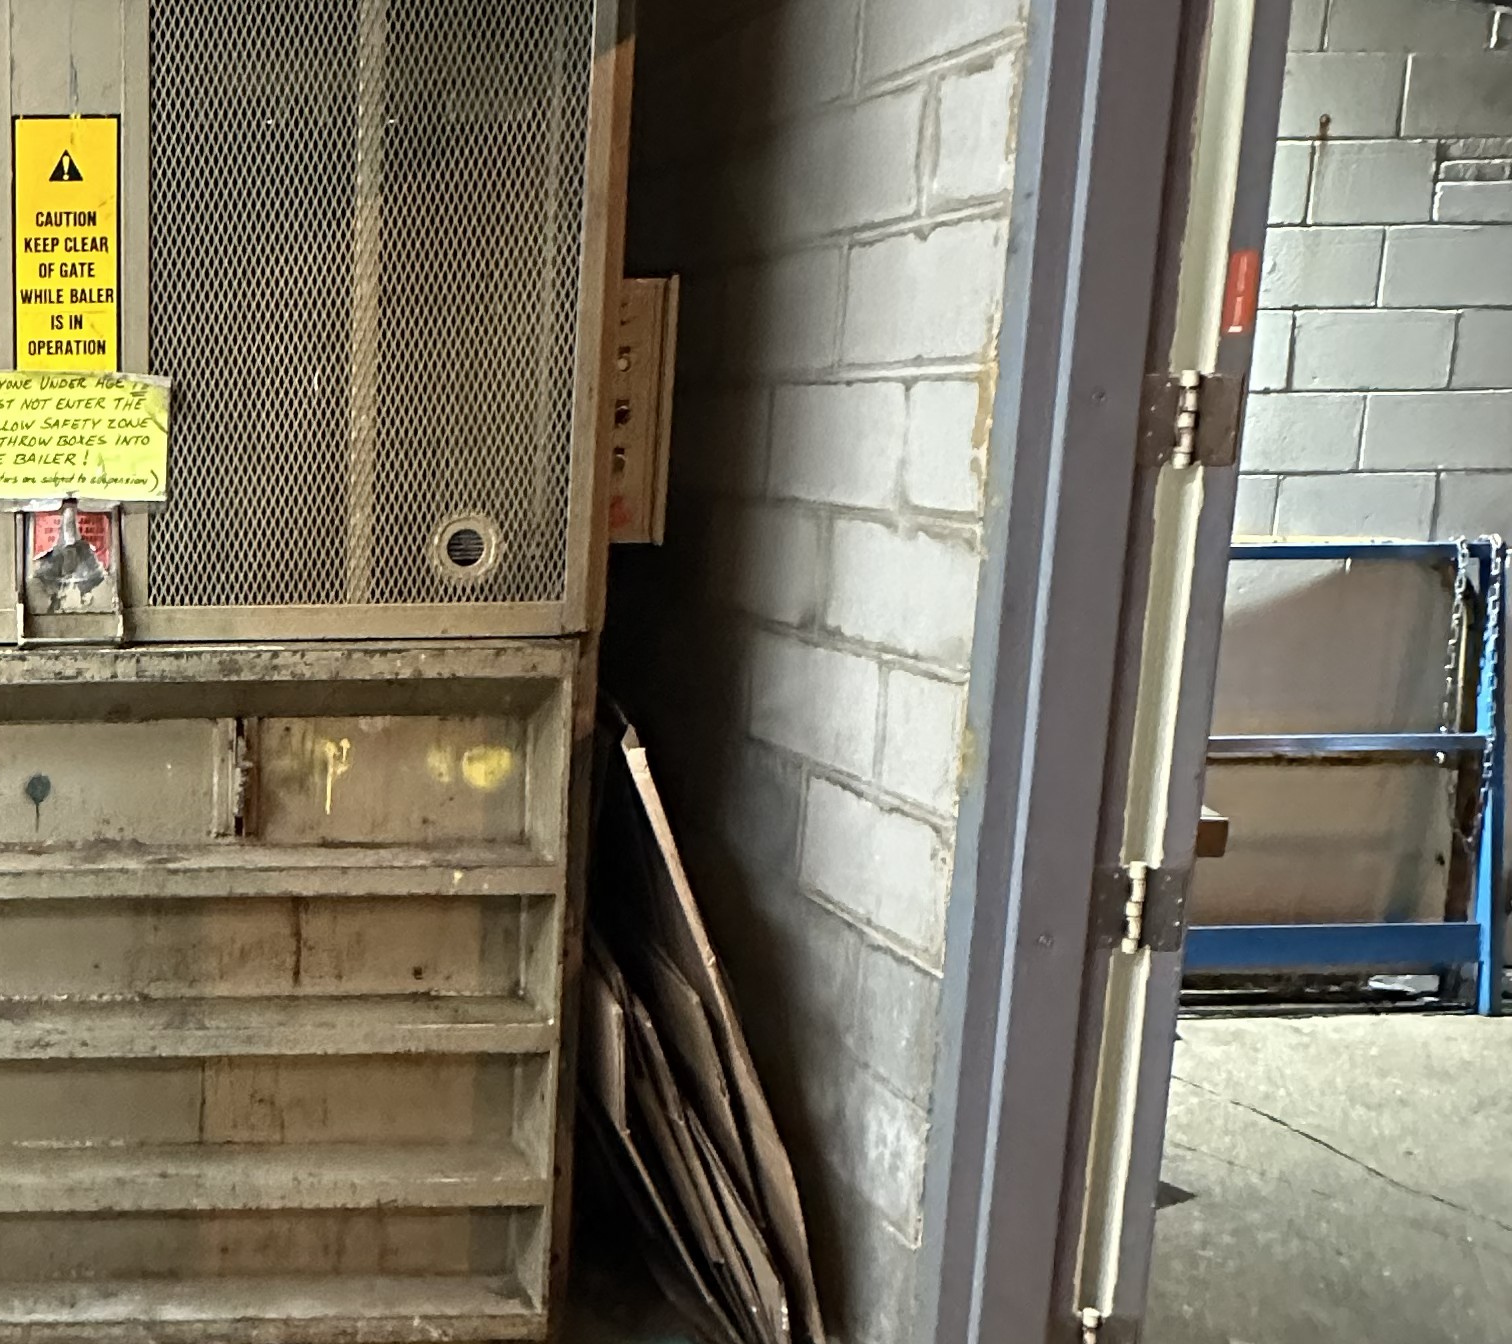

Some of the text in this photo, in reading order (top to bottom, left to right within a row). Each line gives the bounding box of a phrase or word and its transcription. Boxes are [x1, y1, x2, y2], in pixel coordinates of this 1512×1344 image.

[35, 210, 97, 227] CAUTION
[24, 236, 109, 253] KEEP CLEAR
[38, 262, 96, 278] OF GATE
[20, 287, 114, 304] WHILE BALER
[50, 314, 83, 330] IS IN
[28, 339, 107, 356] OPERATION
[40, 376, 87, 390] UNDER
[95, 375, 125, 390] AGE
[20, 397, 52, 411] NOT
[55, 397, 106, 410] ENTER
[114, 397, 147, 411] THE
[40, 417, 102, 431] SAFETY
[107, 417, 151, 429] ZONE
[56, 434, 107, 447] BOXES
[115, 434, 150, 446] INTO
[77, 472, 87, 484] to
